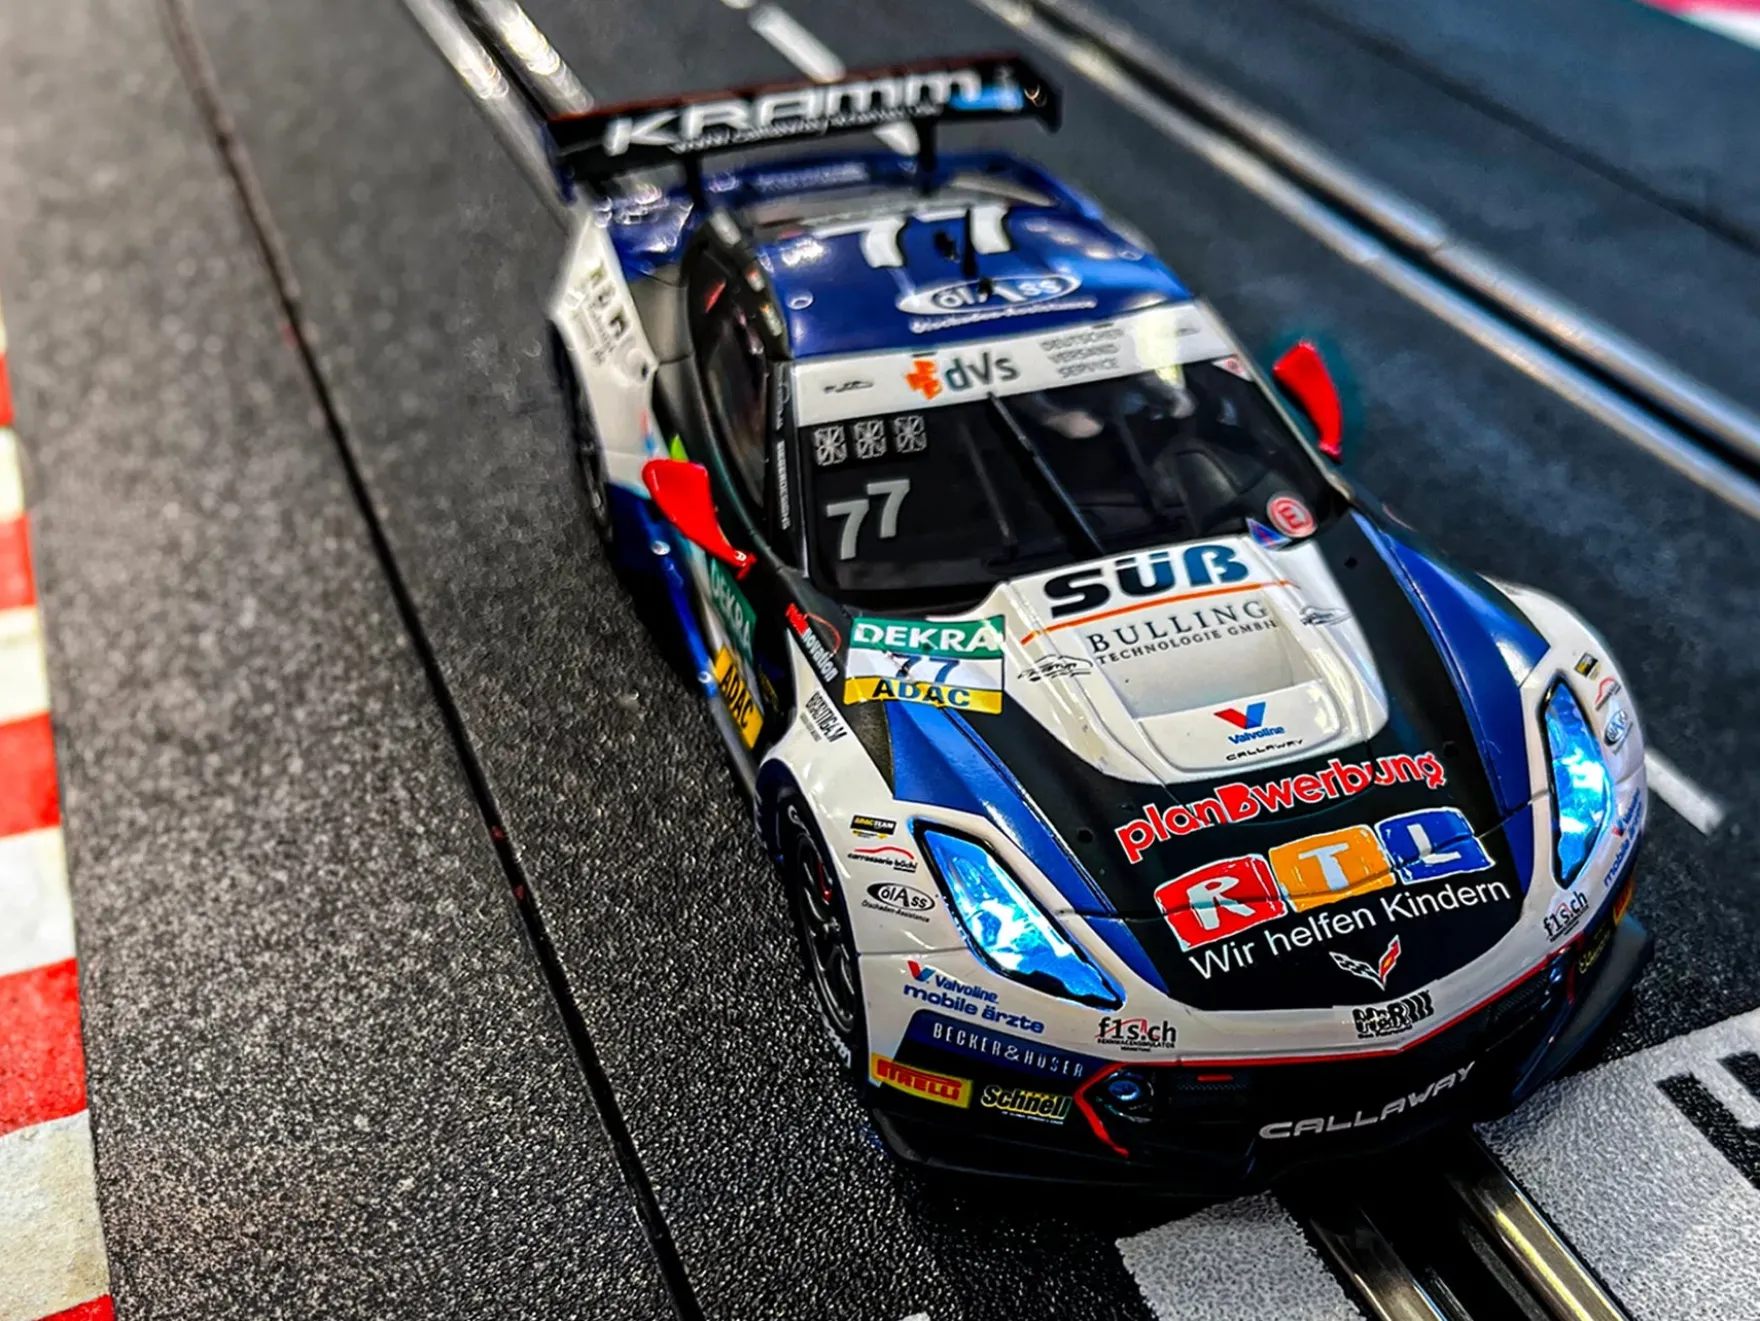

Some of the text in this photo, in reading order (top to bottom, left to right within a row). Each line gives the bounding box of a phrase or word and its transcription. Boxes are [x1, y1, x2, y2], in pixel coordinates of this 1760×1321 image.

[827, 479, 910, 560] 77
[853, 623, 1003, 651] DEKRA
[1086, 600, 1268, 653] BULLING
[1096, 630, 1222, 664] TECHNOLOGIE
[896, 655, 960, 683] 77
[720, 664, 754, 728] ADAC
[871, 679, 970, 708] ADAC
[1225, 738, 1303, 761] CALLAWAY
[1228, 726, 1285, 745] Valvoline
[1187, 824, 1461, 930] RTL
[1189, 881, 1511, 979] Wir helfen Kindern
[935, 974, 999, 1003] Valvoline
[903, 984, 1045, 1034] mobile ärzte
[980, 1085, 1073, 1119] Schnell
[1259, 1060, 1475, 1139] CALLAWAY
